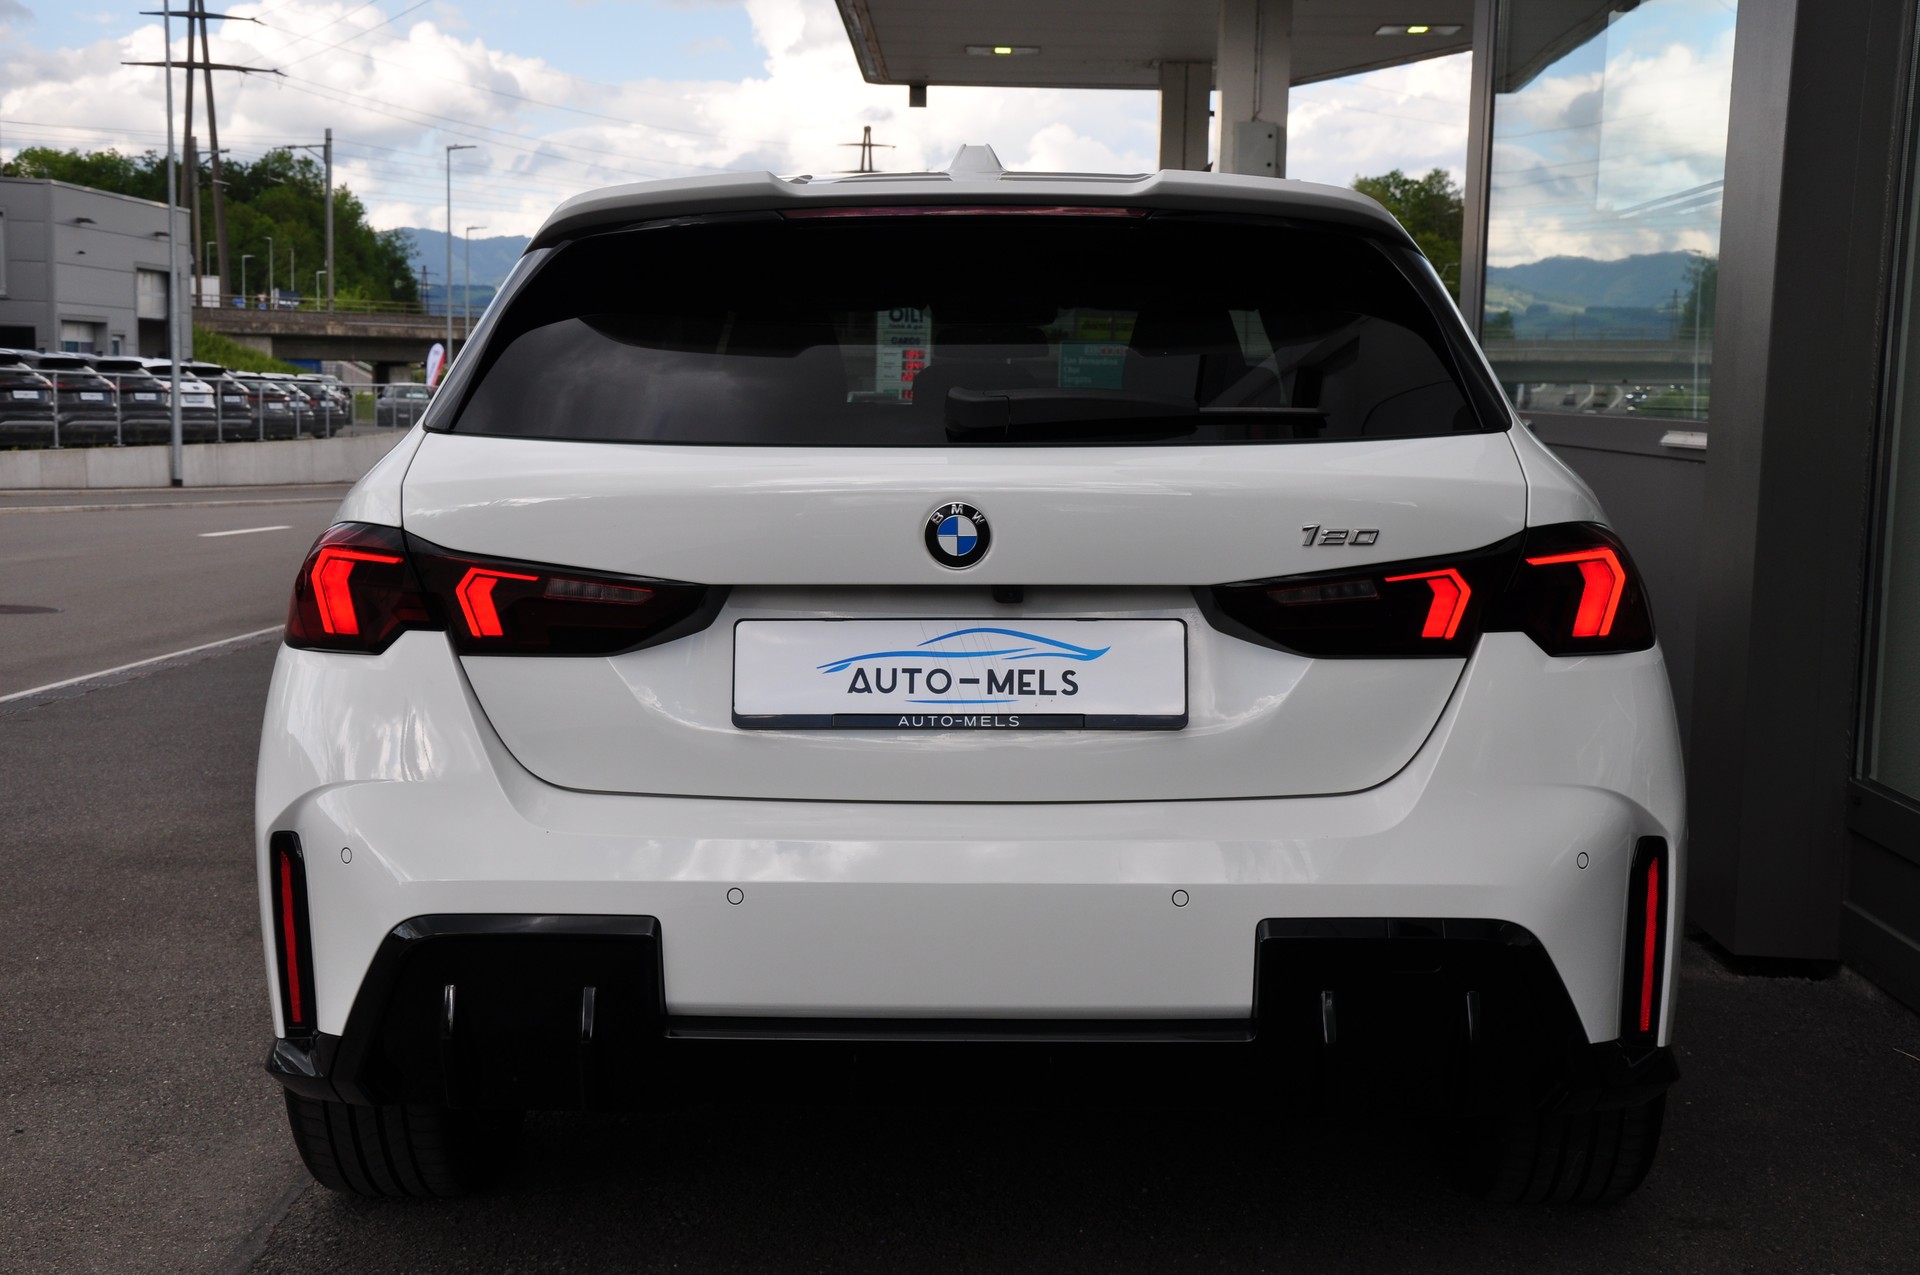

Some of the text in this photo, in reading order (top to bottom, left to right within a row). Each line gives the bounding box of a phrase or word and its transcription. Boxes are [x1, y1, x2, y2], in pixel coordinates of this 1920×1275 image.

[930, 504, 985, 525] BMW
[1302, 523, 1379, 544] 120
[848, 667, 1079, 696] AUTO-MELS
[897, 715, 1021, 727] AUTO-MELS
